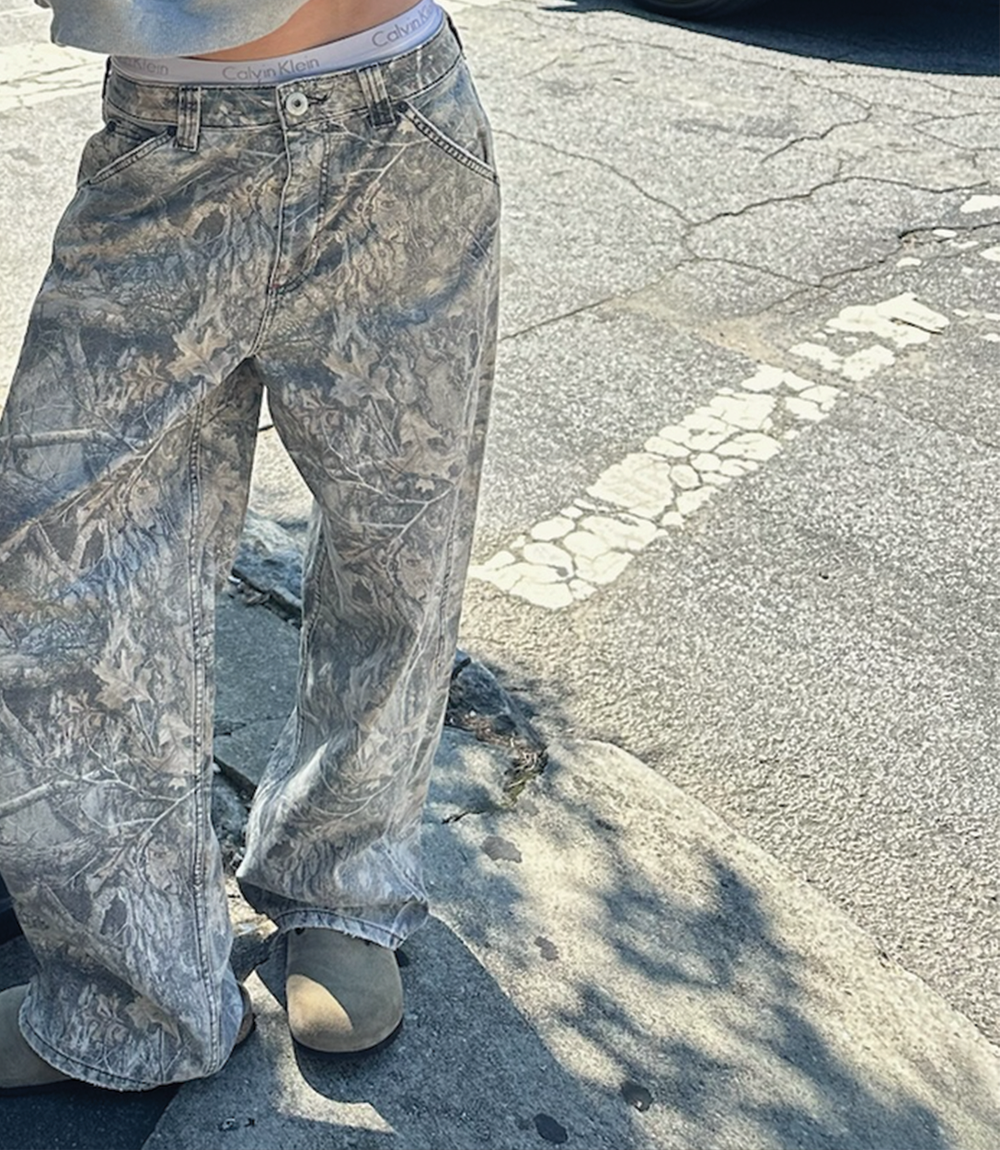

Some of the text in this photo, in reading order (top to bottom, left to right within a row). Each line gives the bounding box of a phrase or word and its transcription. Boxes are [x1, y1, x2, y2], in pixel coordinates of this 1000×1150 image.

[372, 13, 420, 48] Calvin
[132, 56, 168, 76] Klein
[222, 56, 320, 83] Calvin Klein
